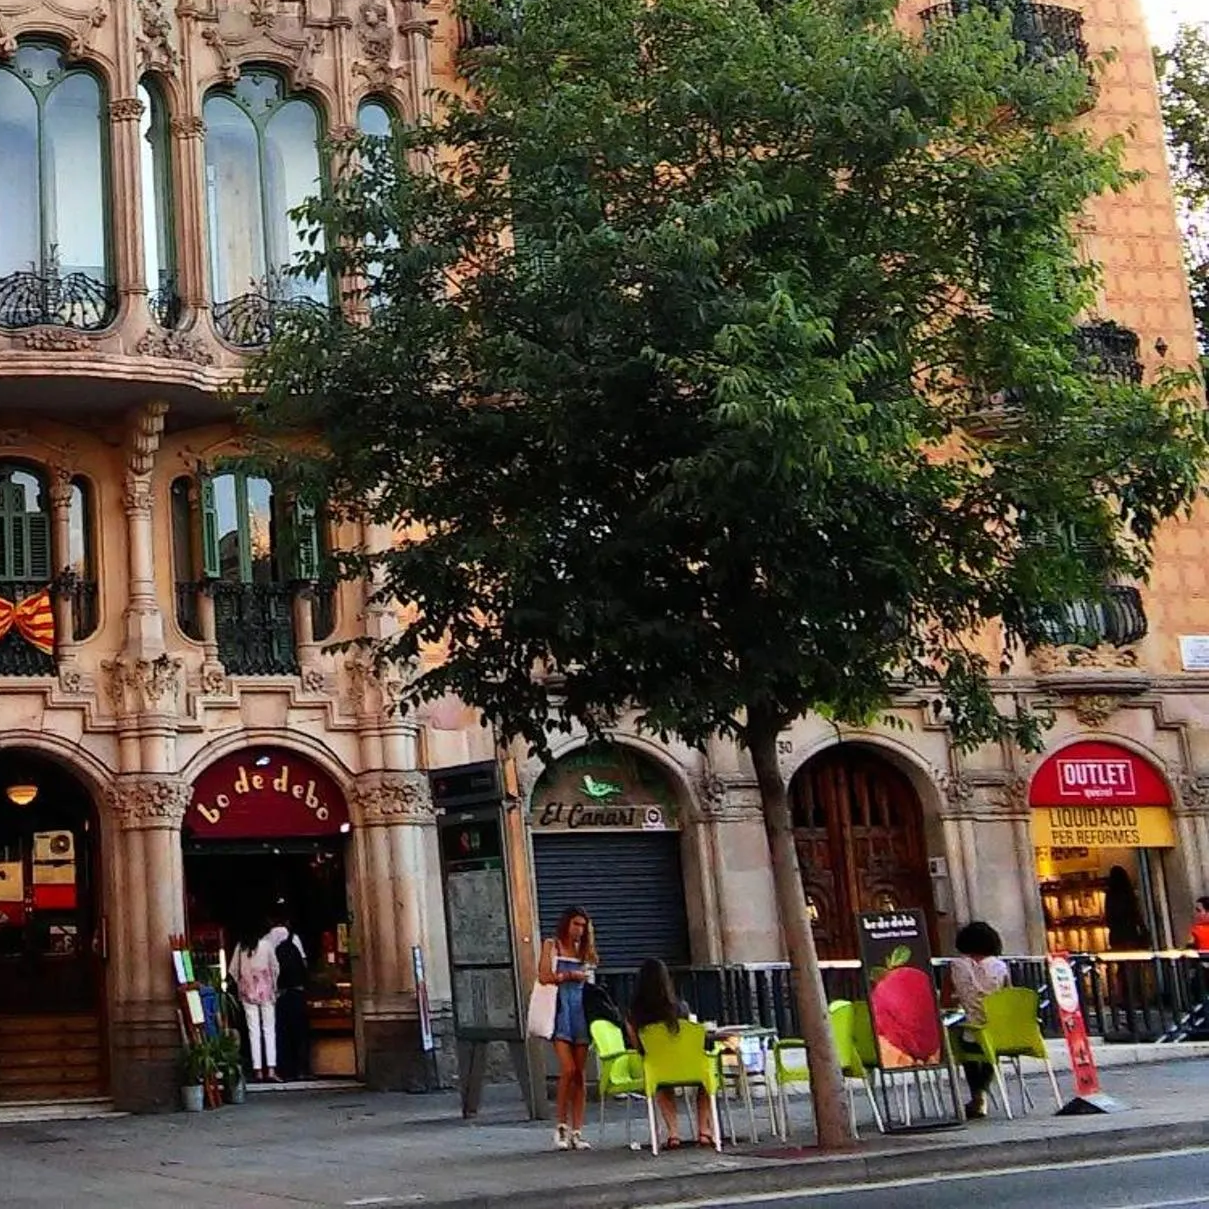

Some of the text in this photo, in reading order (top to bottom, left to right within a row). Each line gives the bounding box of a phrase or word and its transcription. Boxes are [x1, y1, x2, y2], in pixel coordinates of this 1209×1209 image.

[1063, 763, 1126, 786] OUTLET
[197, 794, 230, 824] bo
[234, 765, 264, 794] de
[541, 802, 562, 826] El
[1052, 829, 1140, 844] PER REFORMES
